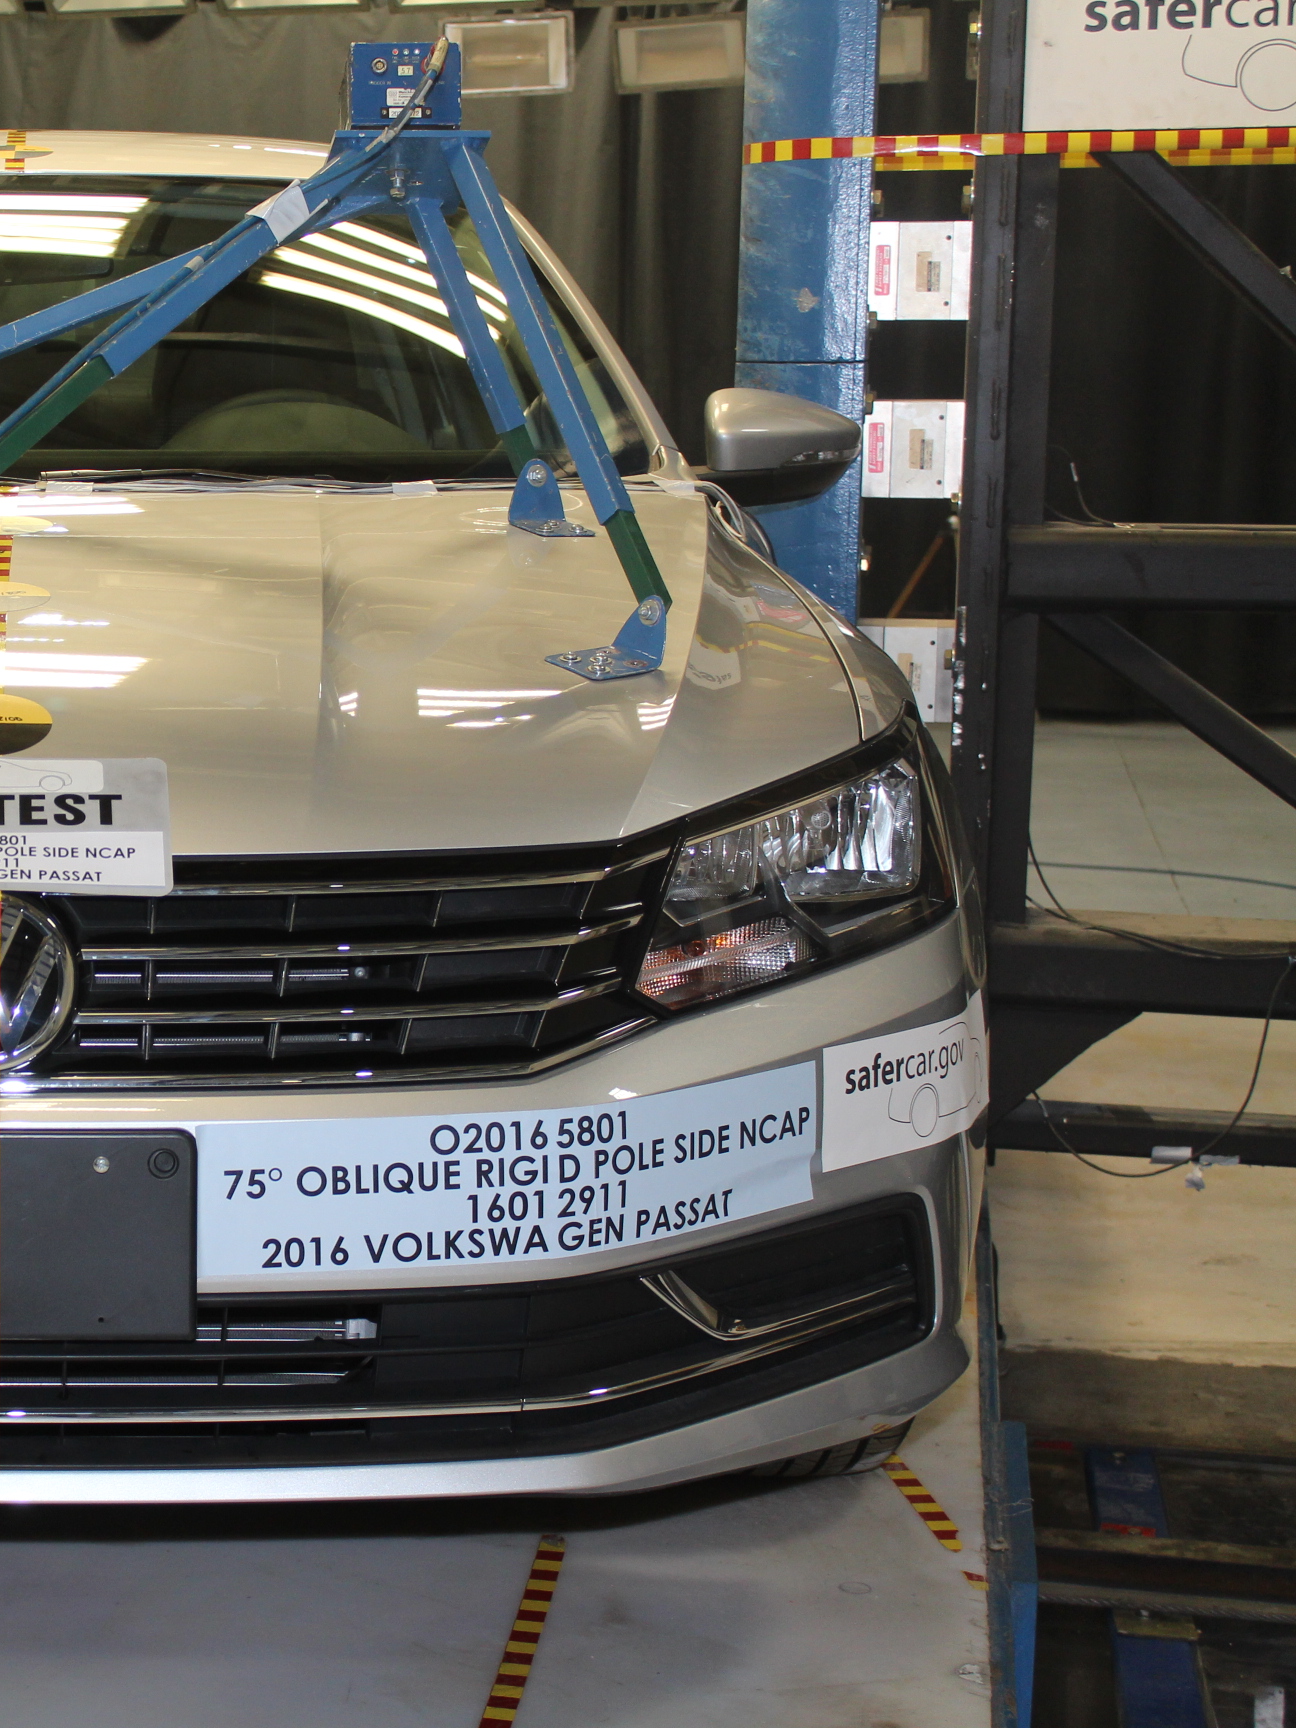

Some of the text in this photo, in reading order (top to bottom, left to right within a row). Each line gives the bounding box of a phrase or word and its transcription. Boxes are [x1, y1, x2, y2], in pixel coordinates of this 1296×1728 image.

[38, 869, 102, 882] PASSAT
[43, 846, 79, 858] SIDE
[85, 847, 136, 859] NCAP
[845, 1038, 964, 1095] safercar.gov
[223, 1106, 810, 1201] 75° OBLIQUE RIGID POLE SIDE NCAP
[466, 1179, 627, 1224] 16012911
[261, 1188, 733, 1269] 2016 VOLKSWAGEN PASSAT
